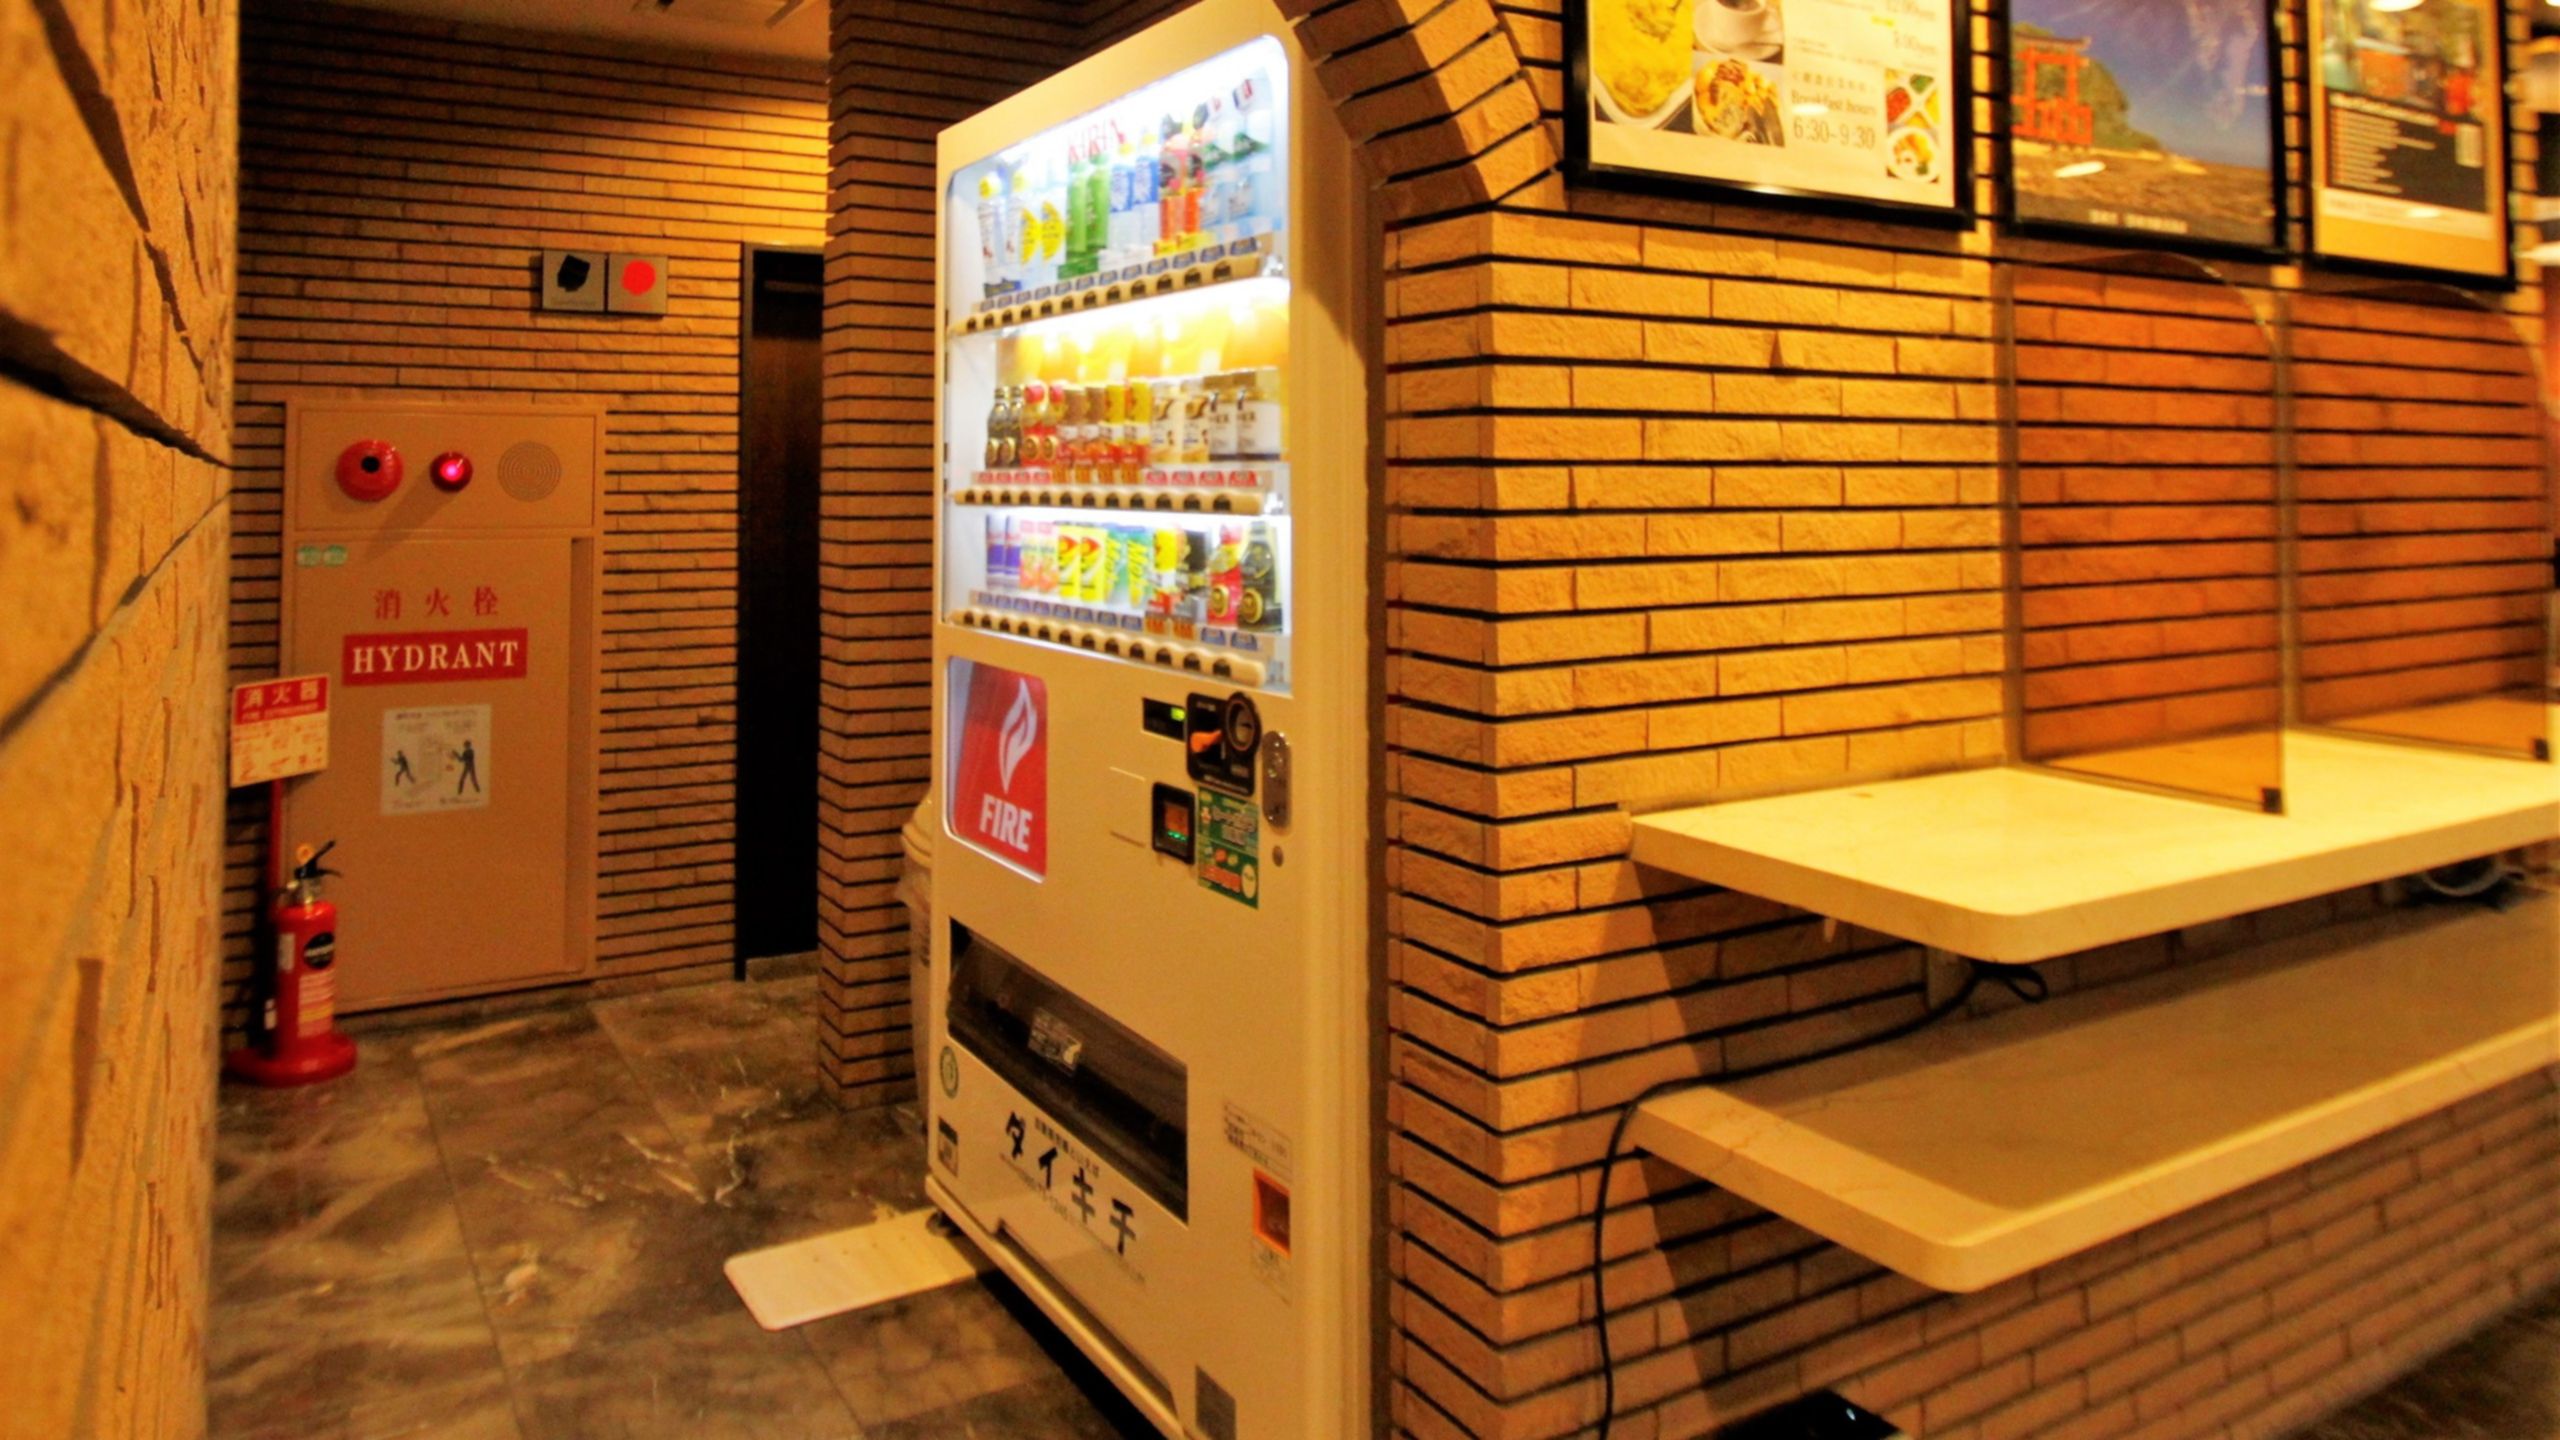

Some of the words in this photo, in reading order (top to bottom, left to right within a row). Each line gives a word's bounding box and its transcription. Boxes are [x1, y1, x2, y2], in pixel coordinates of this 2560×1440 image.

[374, 586, 499, 620] 消火栓
[352, 641, 519, 674] HYDRANT
[979, 791, 1034, 853] FIRE
